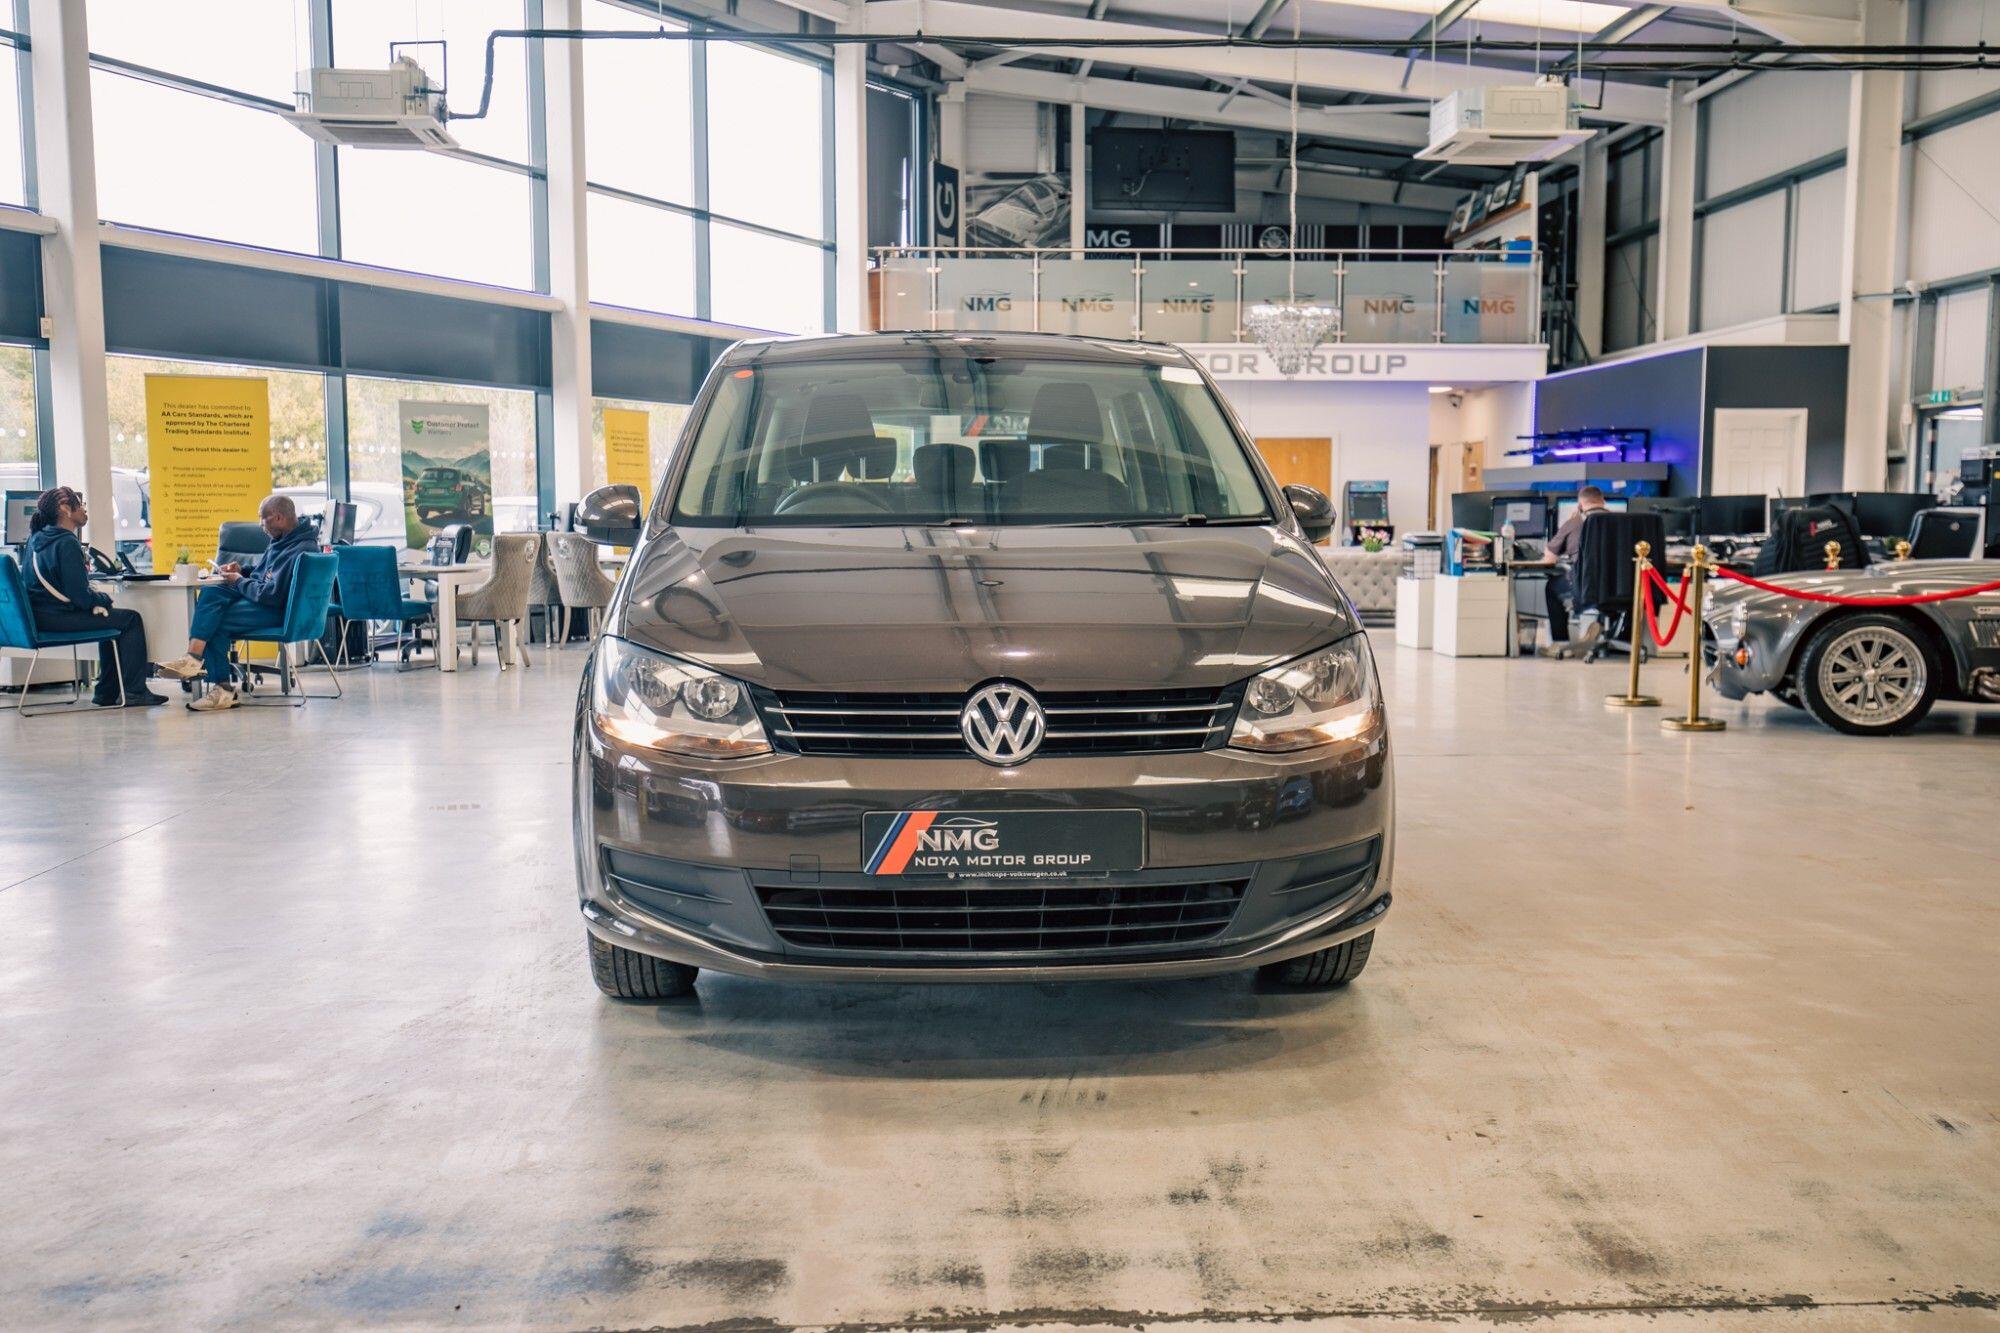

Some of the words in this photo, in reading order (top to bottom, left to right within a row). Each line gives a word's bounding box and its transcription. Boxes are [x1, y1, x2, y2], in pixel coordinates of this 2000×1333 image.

[962, 297, 1012, 312] NMG
[1061, 298, 1114, 312] NMG
[1163, 299, 1215, 313] NMG
[1464, 299, 1516, 314] NMG
[1197, 354, 1259, 374] OR
[197, 420, 205, 428] by
[962, 684, 1045, 763] VW
[916, 828, 1000, 851] NMG
[914, 856, 960, 867] NOYA
[966, 855, 1026, 866] MOTOR
[1033, 854, 1092, 865] GROUP
